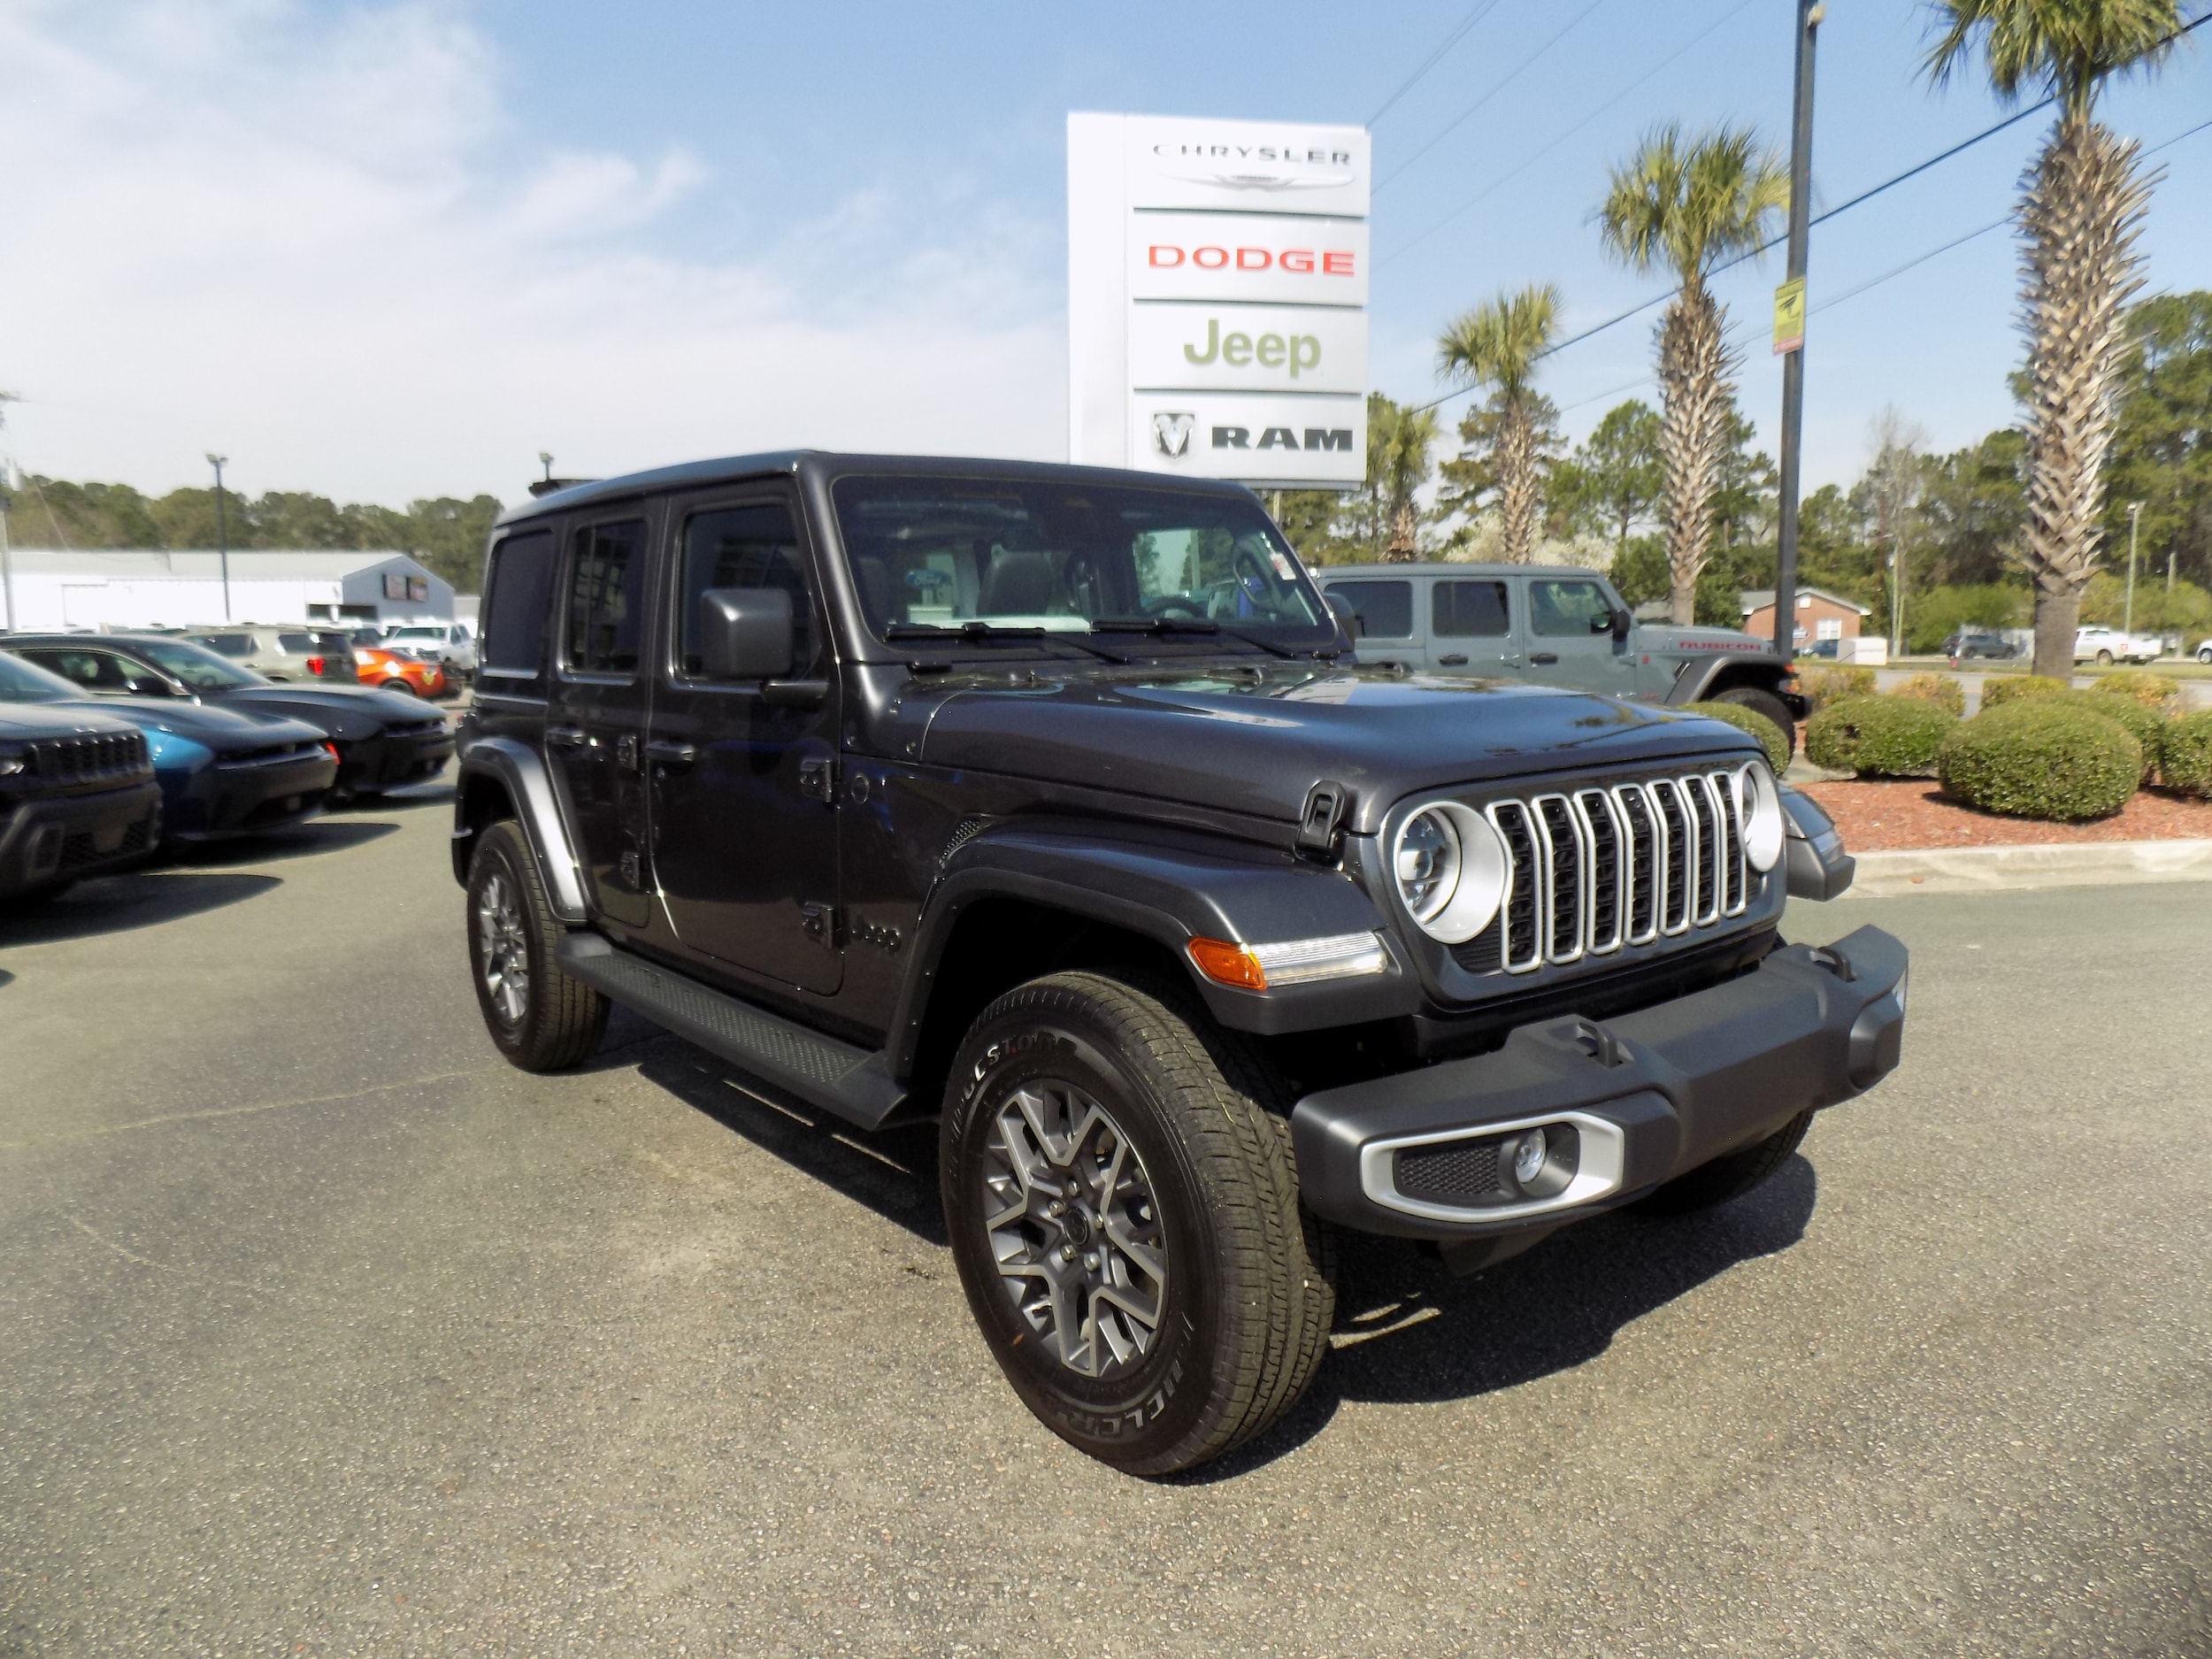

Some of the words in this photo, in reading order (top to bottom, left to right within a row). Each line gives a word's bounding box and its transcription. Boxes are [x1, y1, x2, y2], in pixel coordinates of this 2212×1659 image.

[1153, 144, 1351, 165] CHRYSLER
[1149, 245, 1356, 276] DODGE
[1184, 319, 1322, 379] Jeep
[1211, 426, 1354, 451] RAM
[1679, 641, 1761, 652] RUBICON
